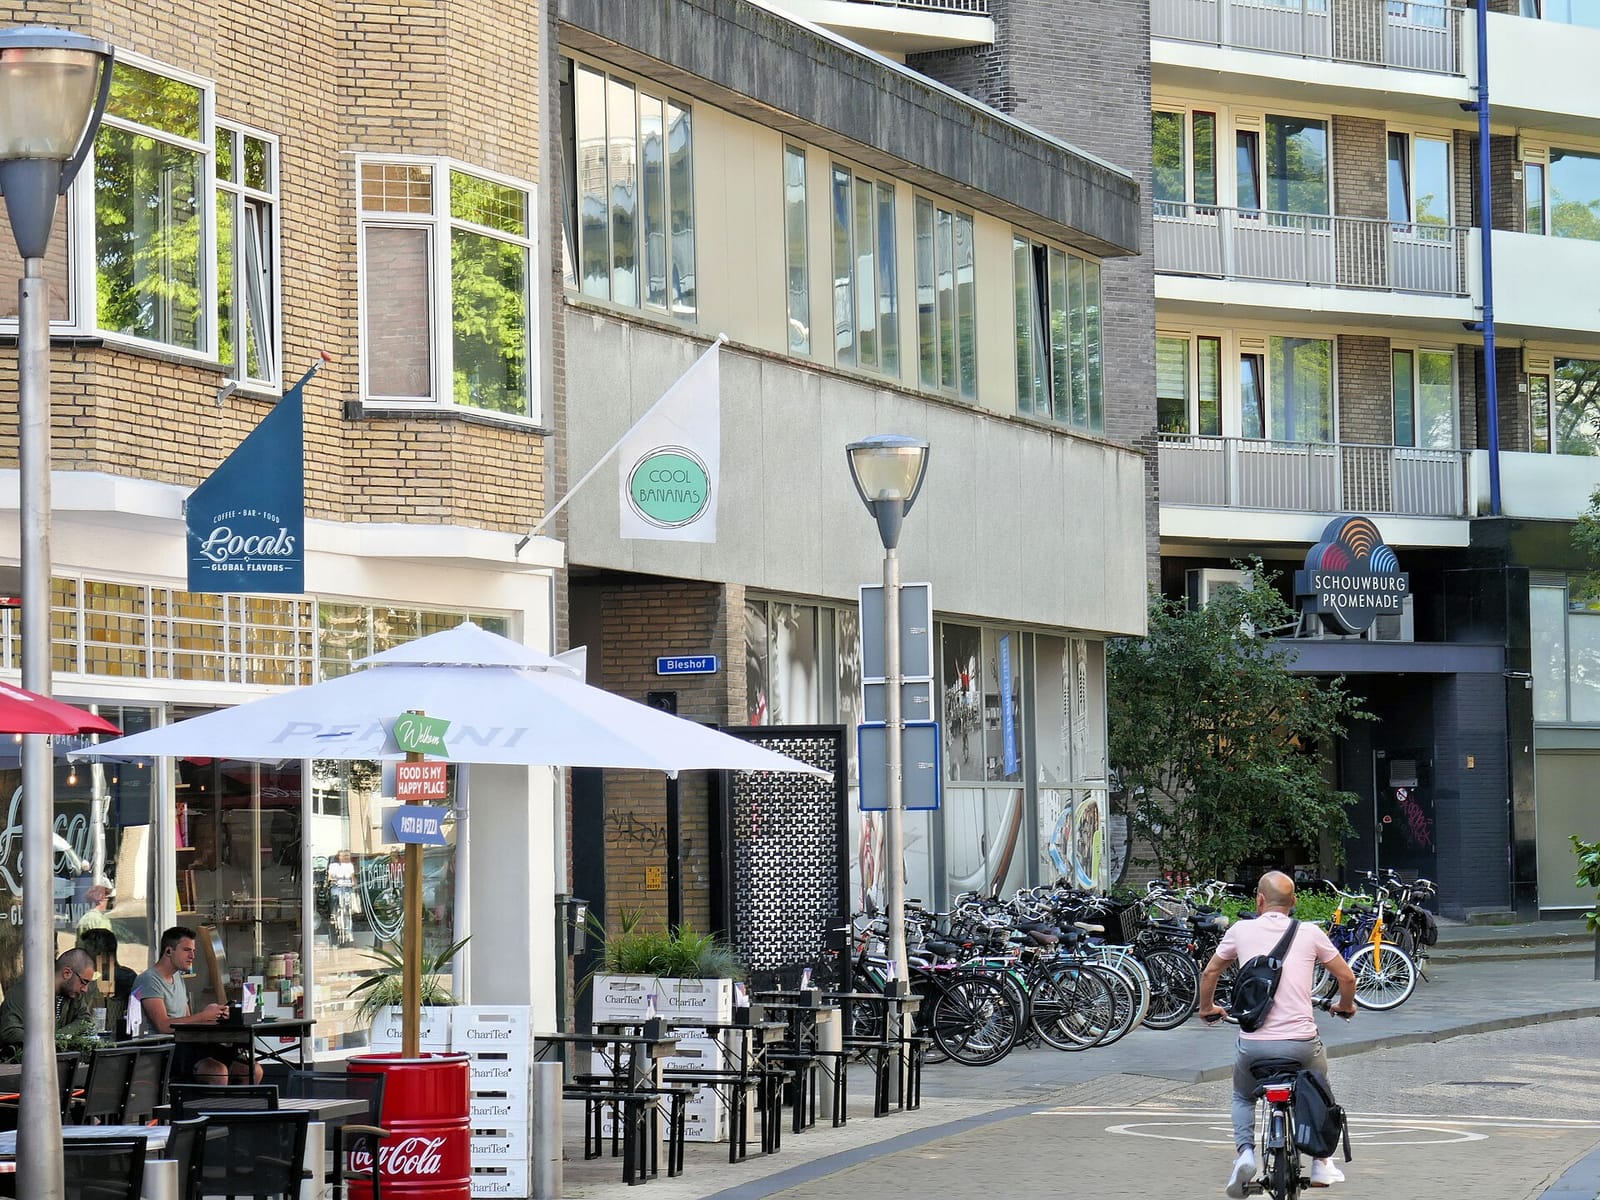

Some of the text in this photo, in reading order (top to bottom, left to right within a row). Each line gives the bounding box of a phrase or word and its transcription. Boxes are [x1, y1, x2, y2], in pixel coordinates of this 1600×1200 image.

[649, 470, 691, 483] COOL
[639, 489, 700, 504] BANANAS
[213, 510, 235, 523] COFFEE
[263, 511, 280, 523] FOOD
[200, 526, 296, 563] Locals
[211, 563, 284, 572] GLOBAL FLAVORS
[1315, 575, 1405, 591] SCHOUWBURG
[1323, 593, 1399, 608] PROMENADE
[667, 659, 706, 669] Bleshof
[399, 767, 442, 780] FOOD IS MY
[398, 781, 445, 795] HAPPY PLACE
[604, 994, 640, 1004] ChariTea
[669, 997, 704, 1007] ChariTea
[467, 1029, 509, 1039] ChariTea
